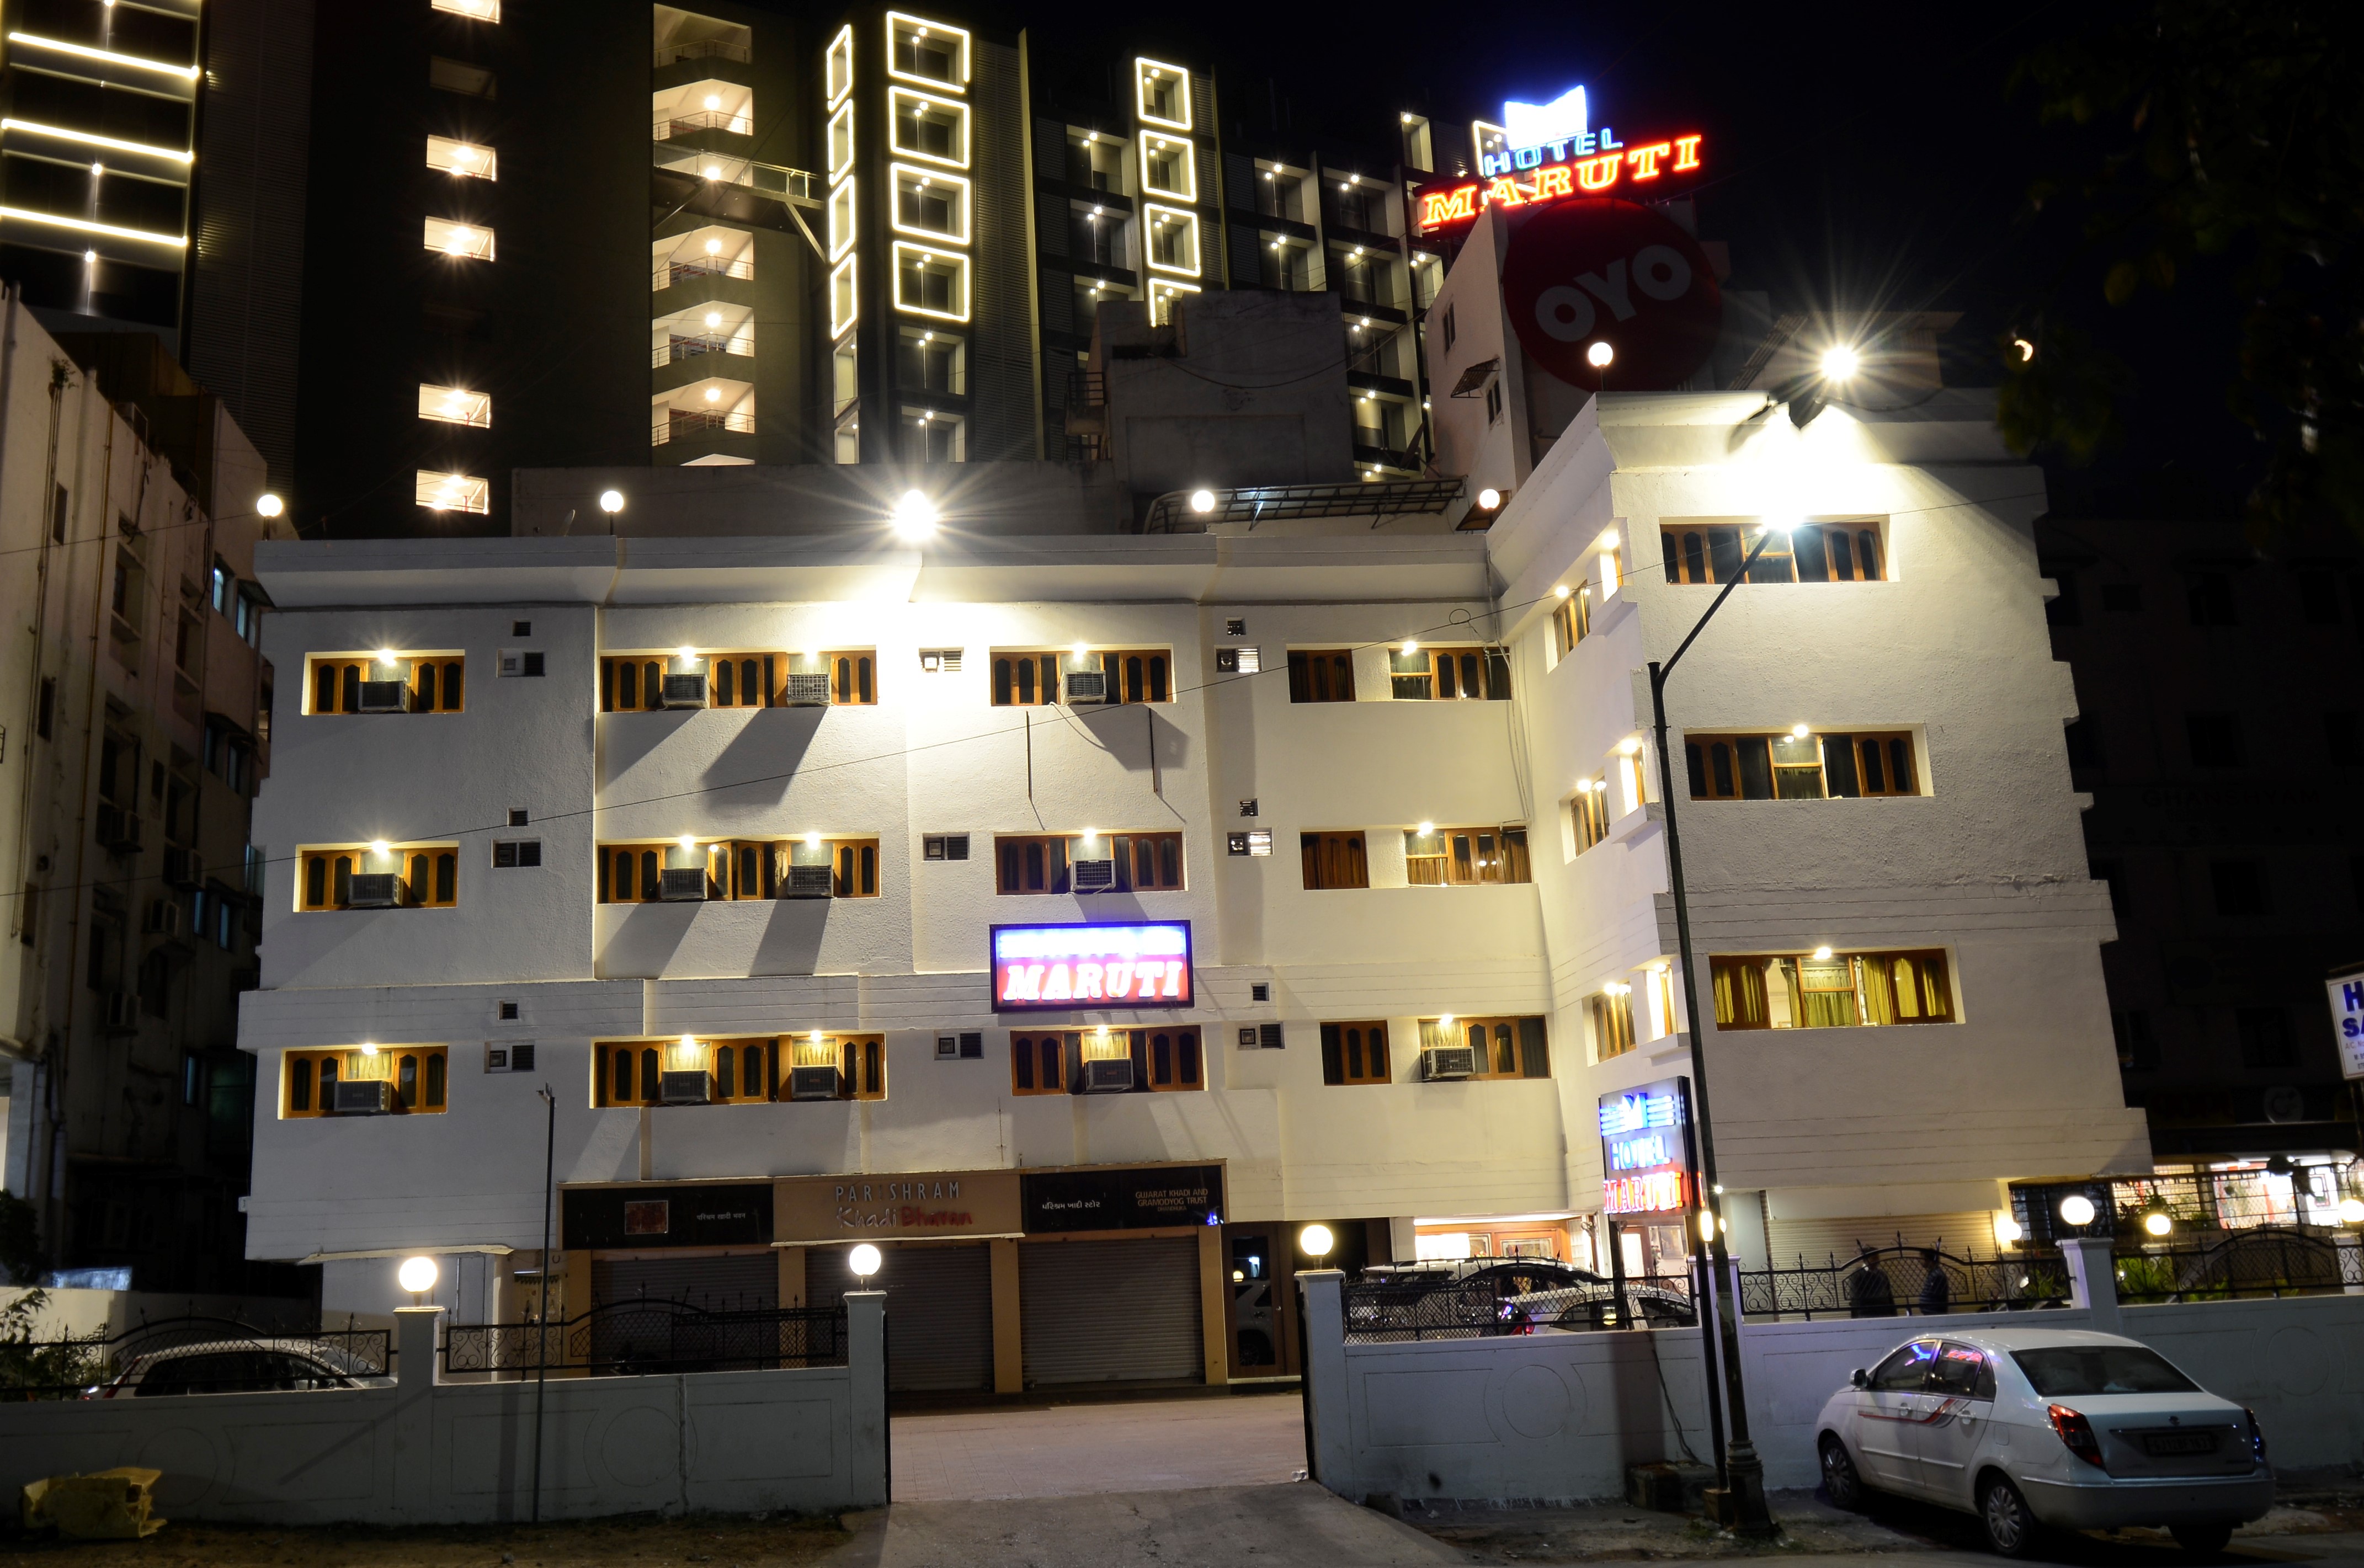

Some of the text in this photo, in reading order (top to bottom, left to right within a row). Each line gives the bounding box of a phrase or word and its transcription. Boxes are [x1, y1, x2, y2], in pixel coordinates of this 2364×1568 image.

[1483, 127, 1623, 178] HOTEL
[1421, 134, 1702, 229] MARUTI
[1535, 243, 1692, 342] OYO
[1002, 961, 1183, 1001] MARUTI
[2342, 1015, 2364, 1038] S
[1610, 1135, 1672, 1170] HOTEL
[835, 1181, 959, 1202] PARISHRAM
[1067, 1200, 1082, 1209] ખાદી
[1084, 1199, 1100, 1208] સ્ટોર
[1135, 1190, 1167, 1199] GUJARAT
[1137, 1196, 1207, 1207] GRAMODYOG TRUST
[1603, 1171, 1685, 1214] MARUTI
[836, 1206, 973, 1229] Khadi Bhavan
